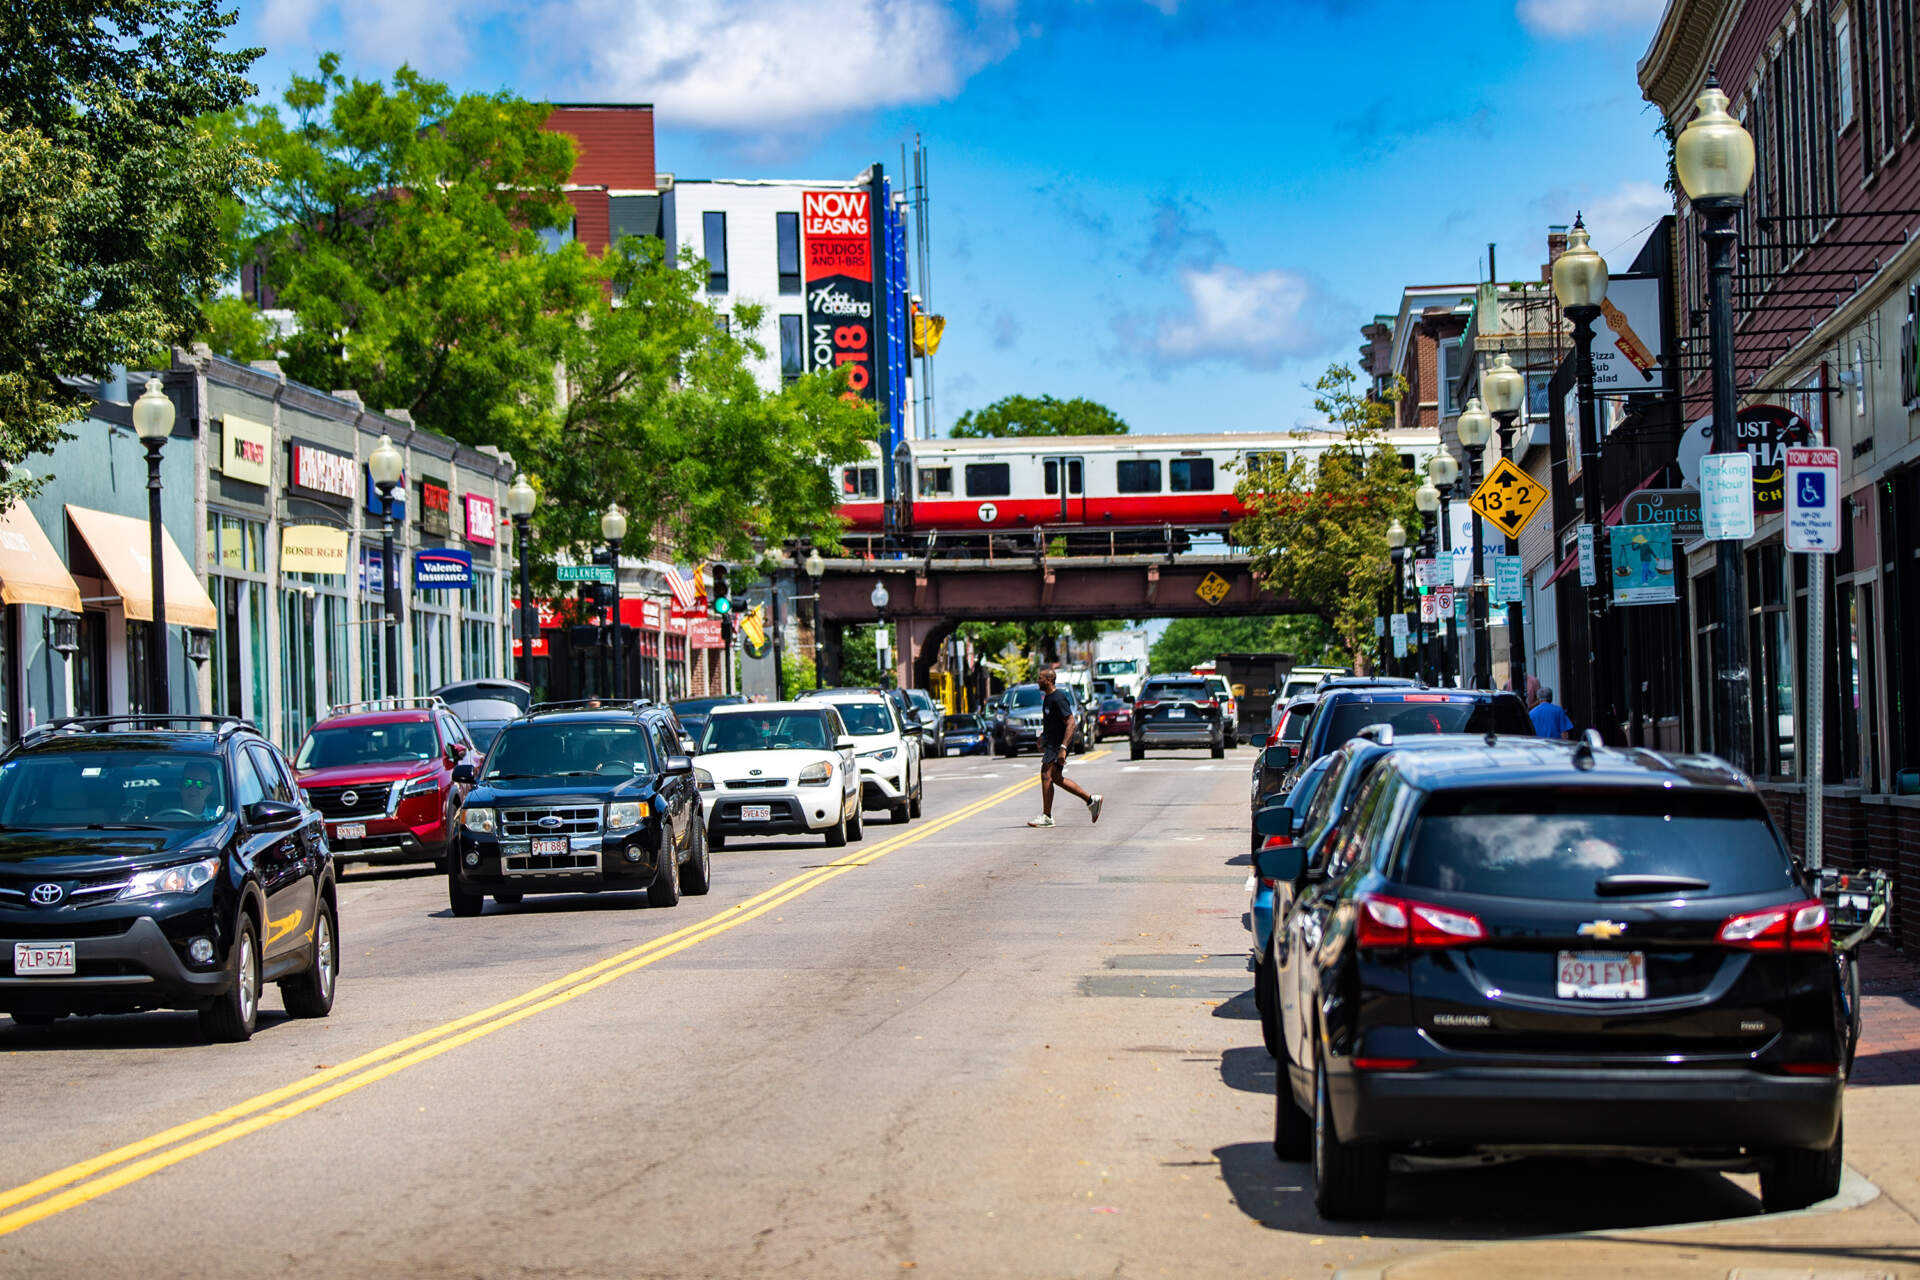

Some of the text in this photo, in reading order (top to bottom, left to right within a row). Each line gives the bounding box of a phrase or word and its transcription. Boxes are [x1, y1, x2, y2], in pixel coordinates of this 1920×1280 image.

[806, 194, 867, 217] NOW
[807, 218, 868, 234] LEASING
[811, 244, 865, 256] STUDIOS
[812, 257, 834, 267] AND
[822, 298, 871, 318] crossing
[1590, 351, 1615, 361] Pizza
[1592, 374, 1618, 383] Salad
[1788, 452, 1837, 464] TOW ZONE
[1704, 466, 1746, 476] Parking
[1707, 480, 1744, 491] 2 Hour
[1712, 493, 1739, 504] Limit
[981, 507, 994, 519] T
[285, 546, 343, 558] BOSBURGER
[423, 563, 463, 572] Valente
[560, 567, 600, 578] FAULKNER
[418, 572, 468, 582] Insurance
[533, 841, 549, 852] 9YT
[551, 841, 567, 852] 889
[19, 951, 71, 967] 7LP 571
[1561, 963, 1598, 986] 691
